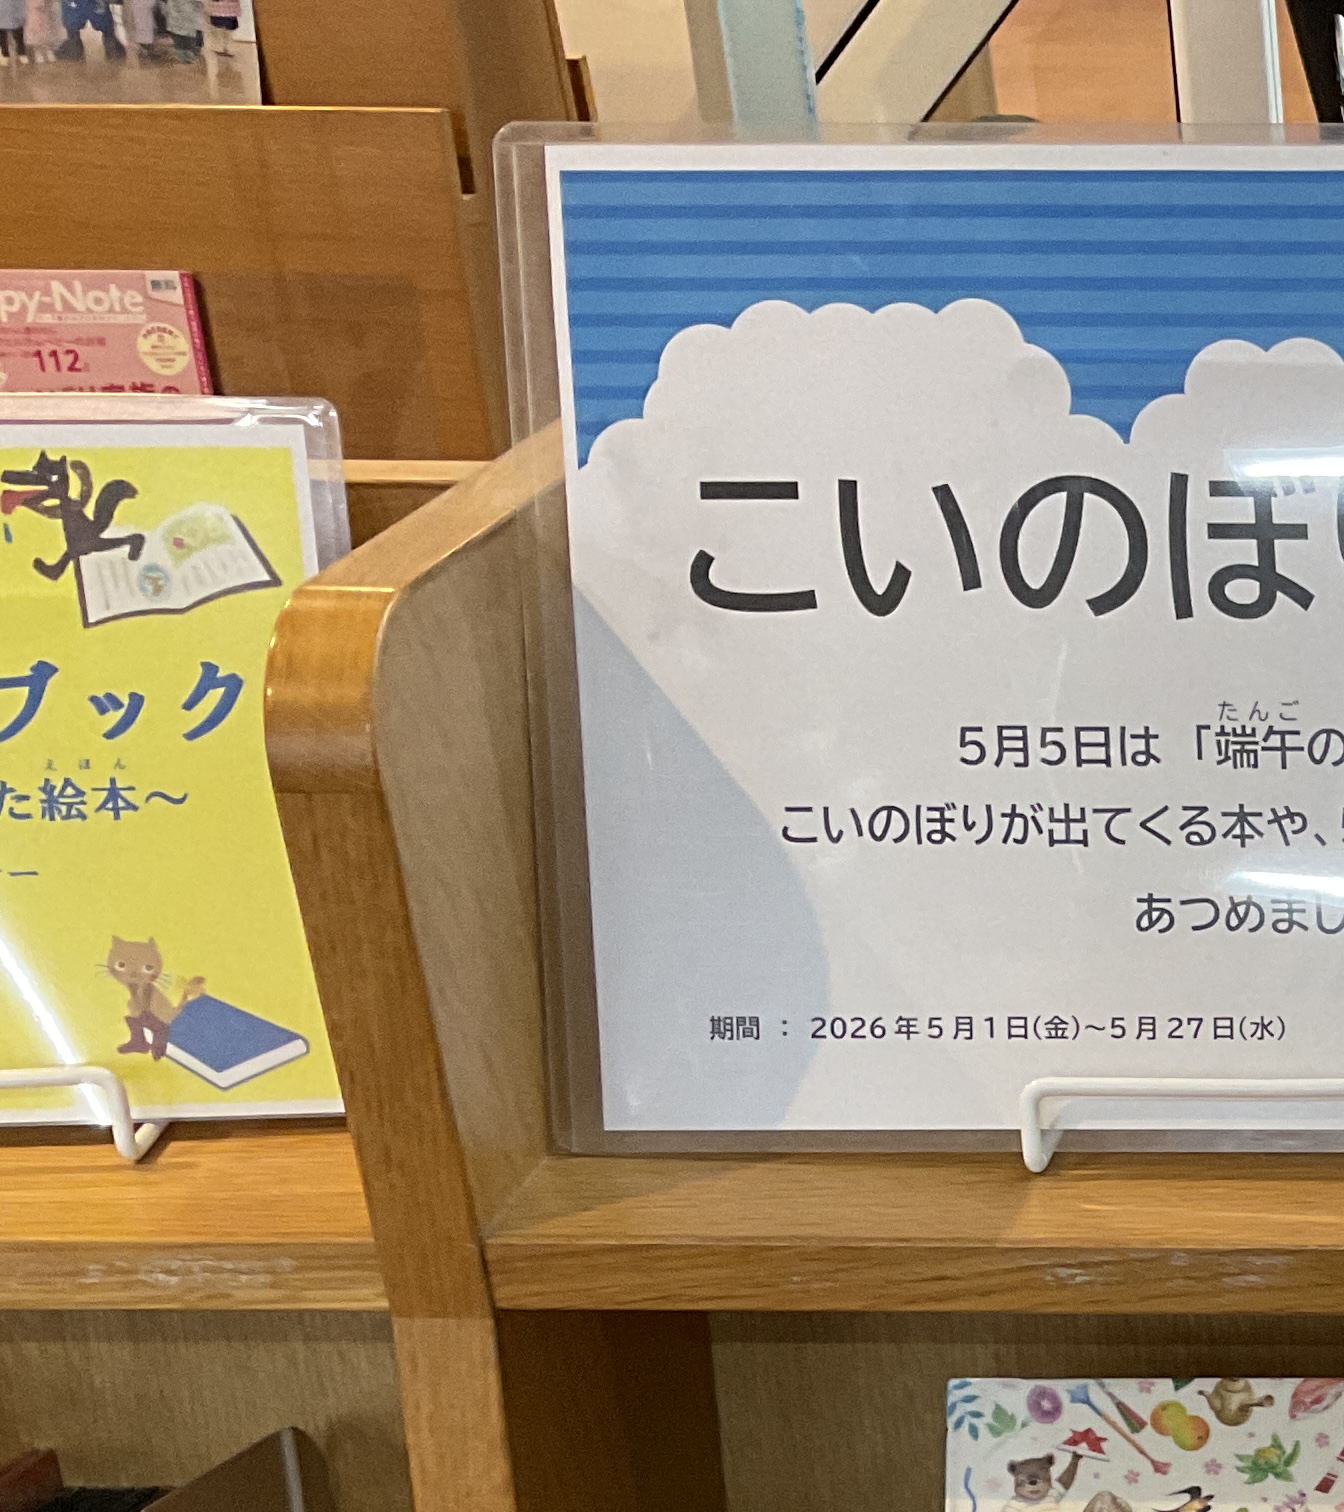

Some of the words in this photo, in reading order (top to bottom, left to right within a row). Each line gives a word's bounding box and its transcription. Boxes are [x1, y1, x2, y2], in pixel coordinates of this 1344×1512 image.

[34, 349, 82, 373] 112
[1218, 700, 1299, 722] たんご
[709, 1015, 760, 1042] 期間
